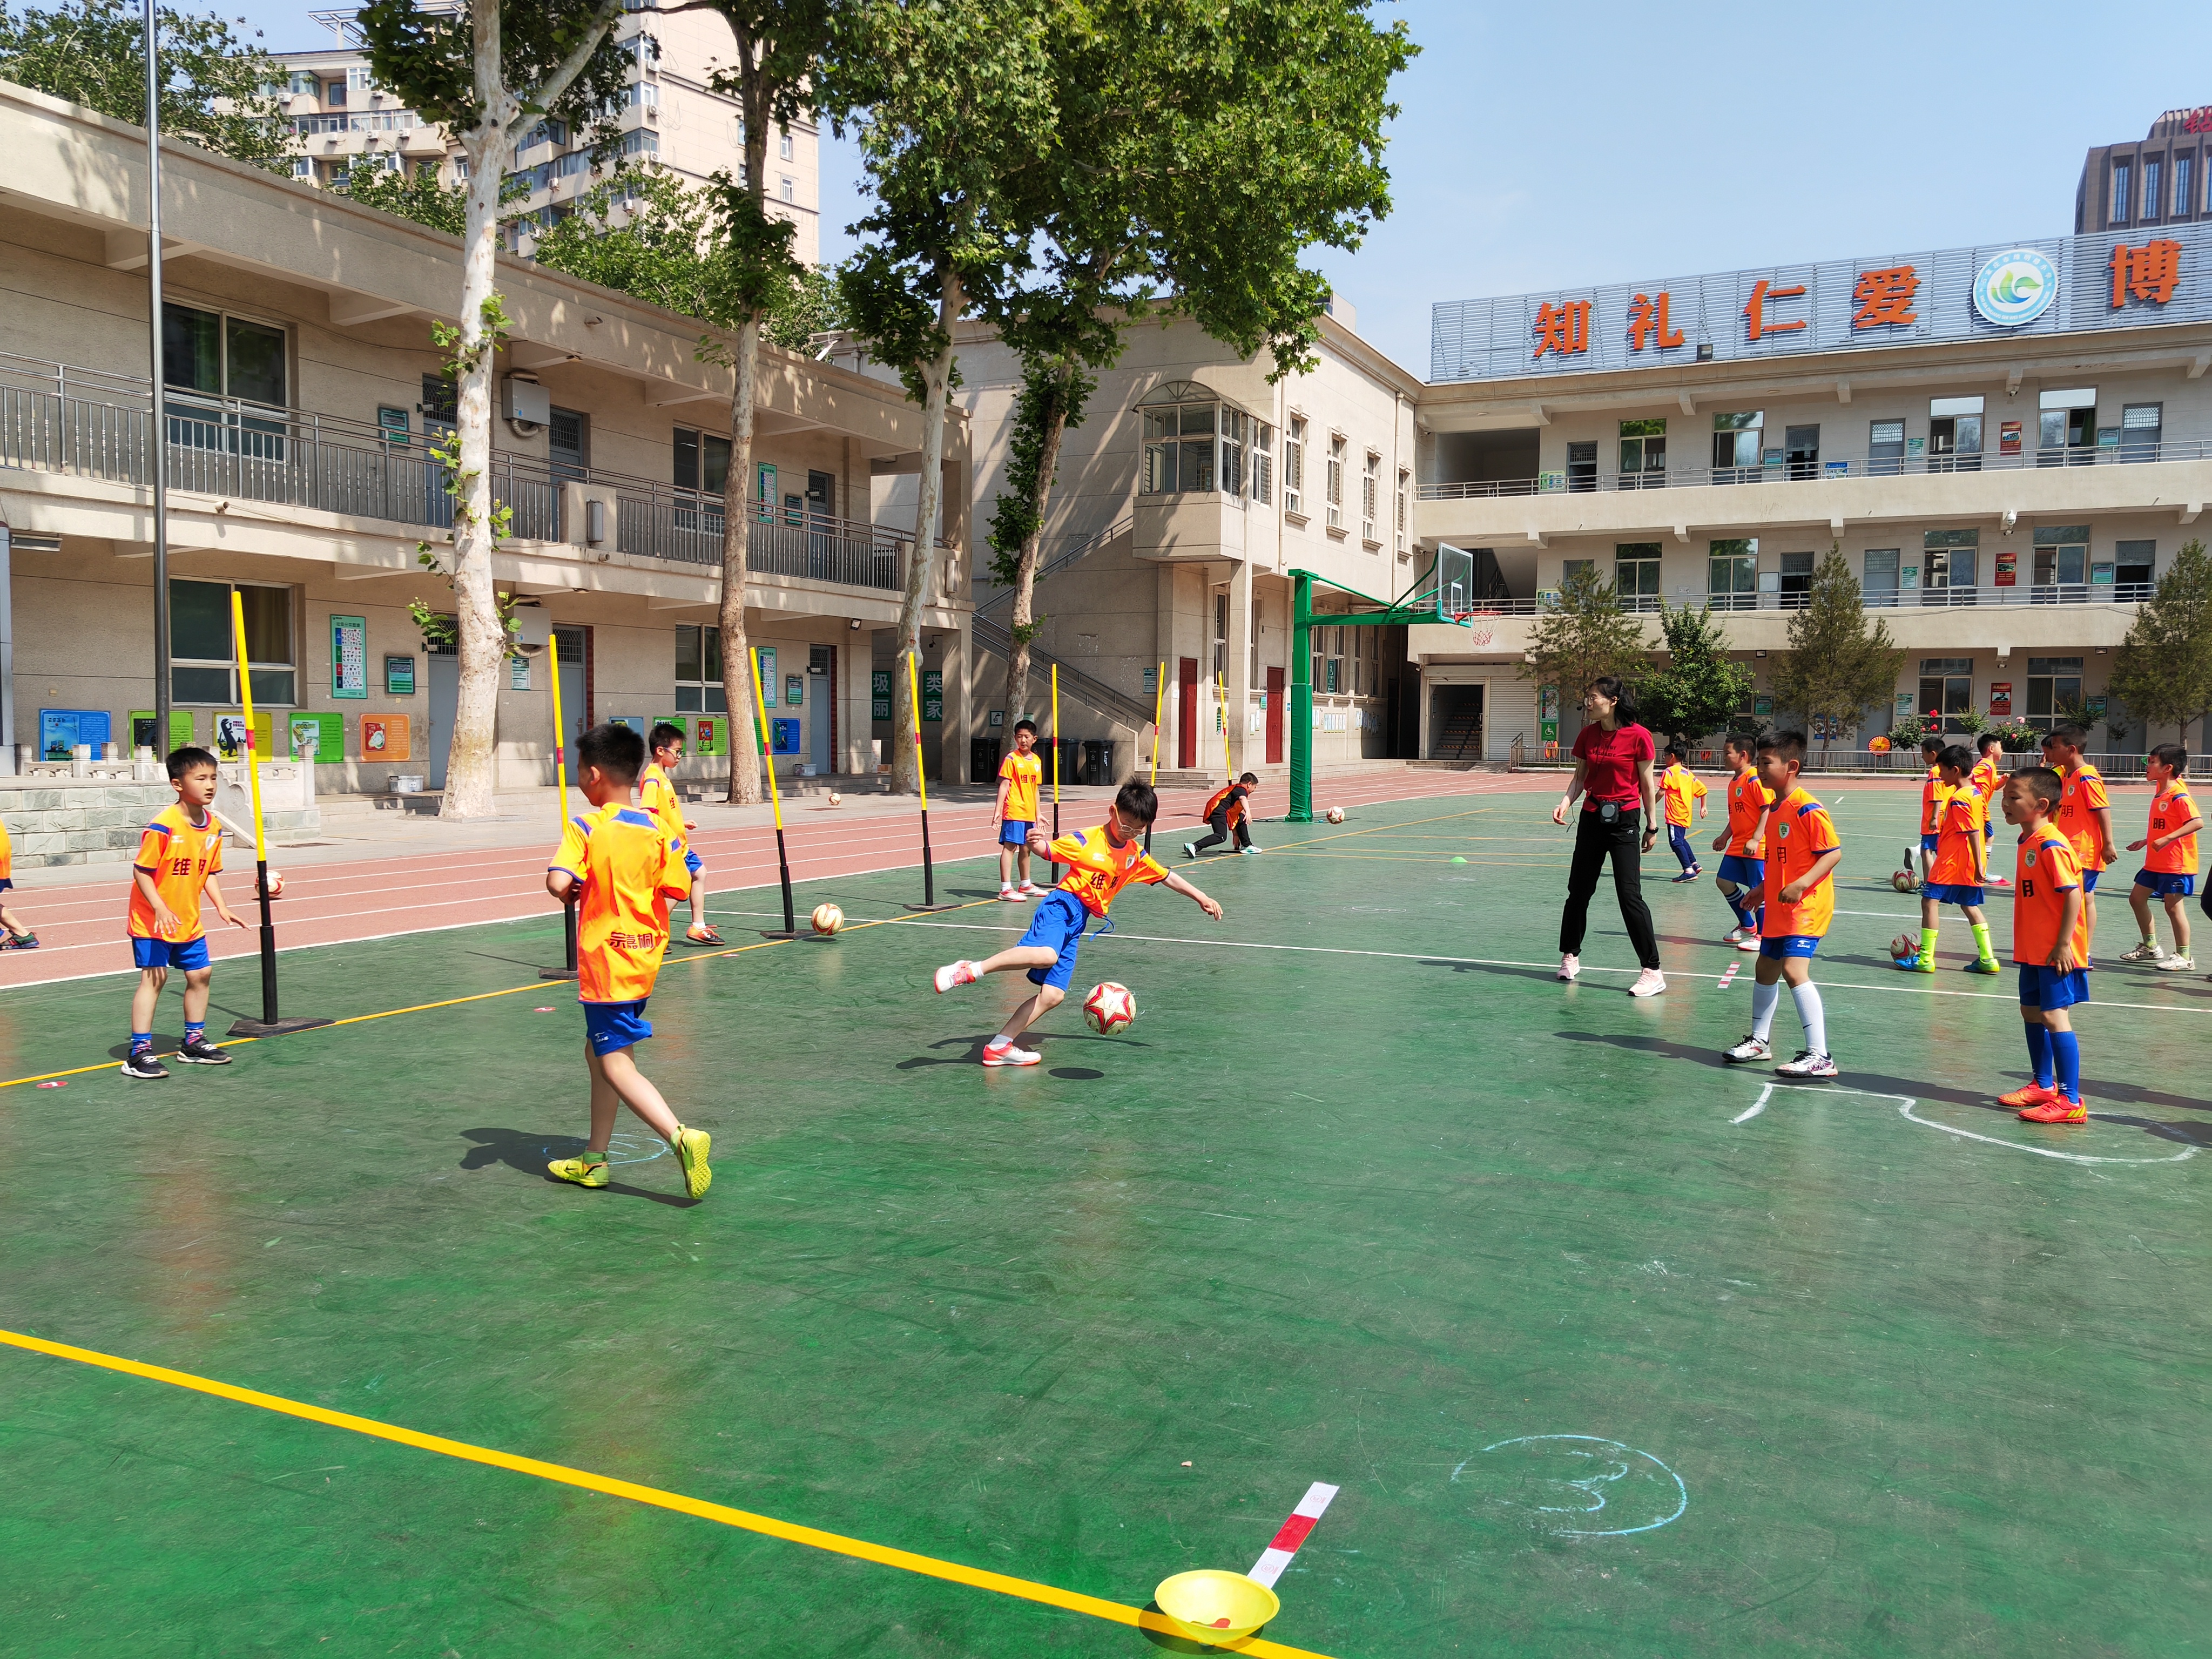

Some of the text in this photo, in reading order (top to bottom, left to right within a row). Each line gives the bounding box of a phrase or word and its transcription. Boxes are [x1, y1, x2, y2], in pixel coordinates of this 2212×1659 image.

[1535, 239, 2183, 358] 知礼仁爱 博
[873, 673, 942, 693] 圾 类
[874, 699, 942, 719] 丽 家
[2153, 818, 2166, 830] 明
